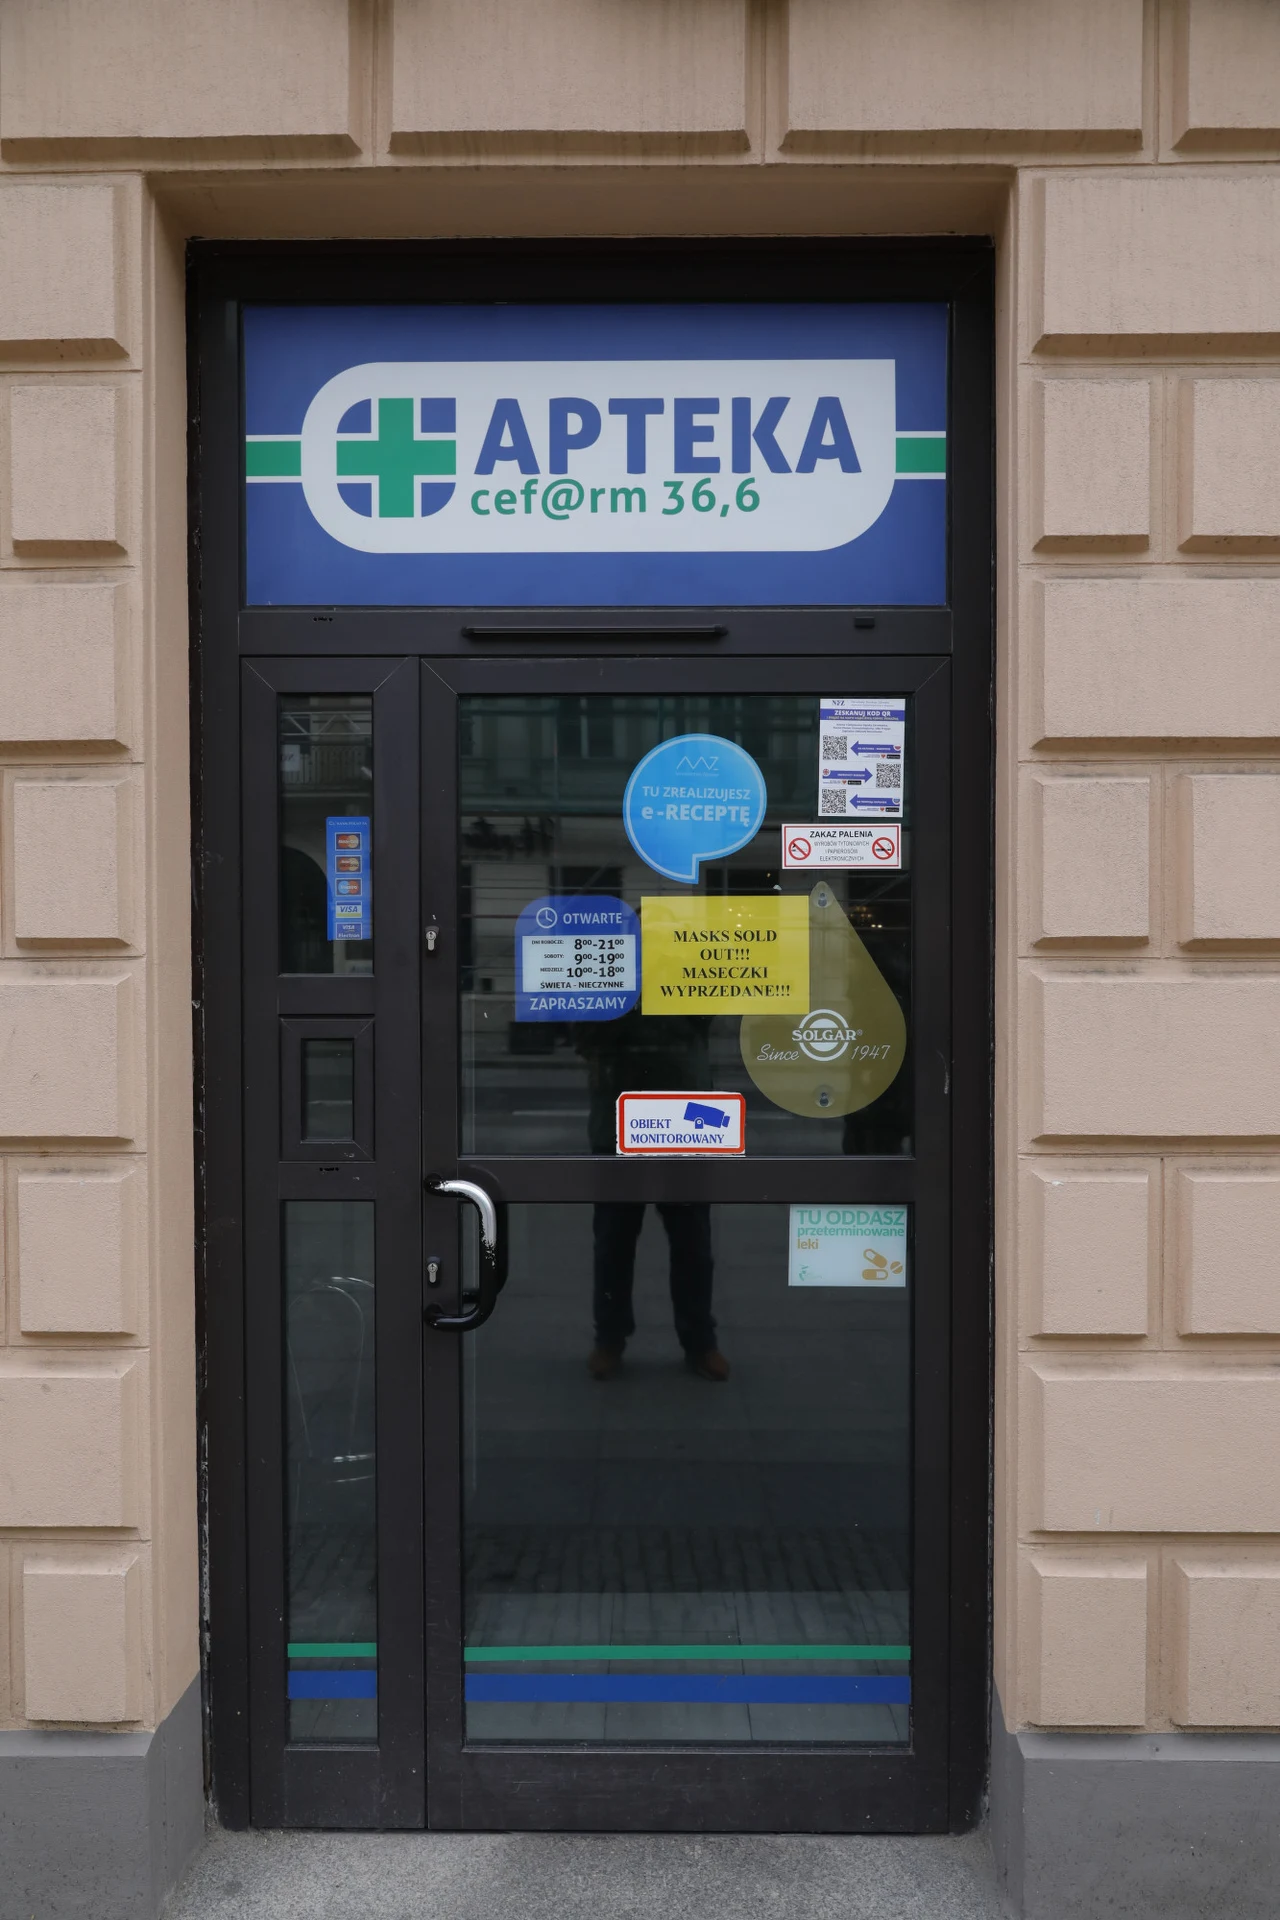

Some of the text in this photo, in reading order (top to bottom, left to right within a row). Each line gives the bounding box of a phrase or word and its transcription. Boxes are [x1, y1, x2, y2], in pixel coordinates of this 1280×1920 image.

[473, 396, 862, 475] APTEKA
[470, 477, 761, 520] cef@rm 36,6
[642, 786, 751, 802] TU ZREALIZUJESZ
[641, 804, 750, 827] e-RECEPTĘ
[563, 912, 623, 925] OTWARTE
[673, 930, 778, 943] MASKS SOLD
[699, 948, 750, 960] OUT!!!
[682, 966, 769, 979] MASECZKI
[578, 981, 624, 989] NIECZYNNE
[660, 984, 791, 997] WYPRZEDANE!!!
[529, 996, 627, 1011] ZAPRASZAMY
[756, 1044, 891, 1061] Since 1947
[630, 1118, 672, 1129] OBIEKT
[630, 1133, 725, 1144] MONITOROWANY
[796, 1209, 905, 1226] TU ODDASZ
[797, 1225, 905, 1238] przeterminowane
[797, 1238, 819, 1250] leki
